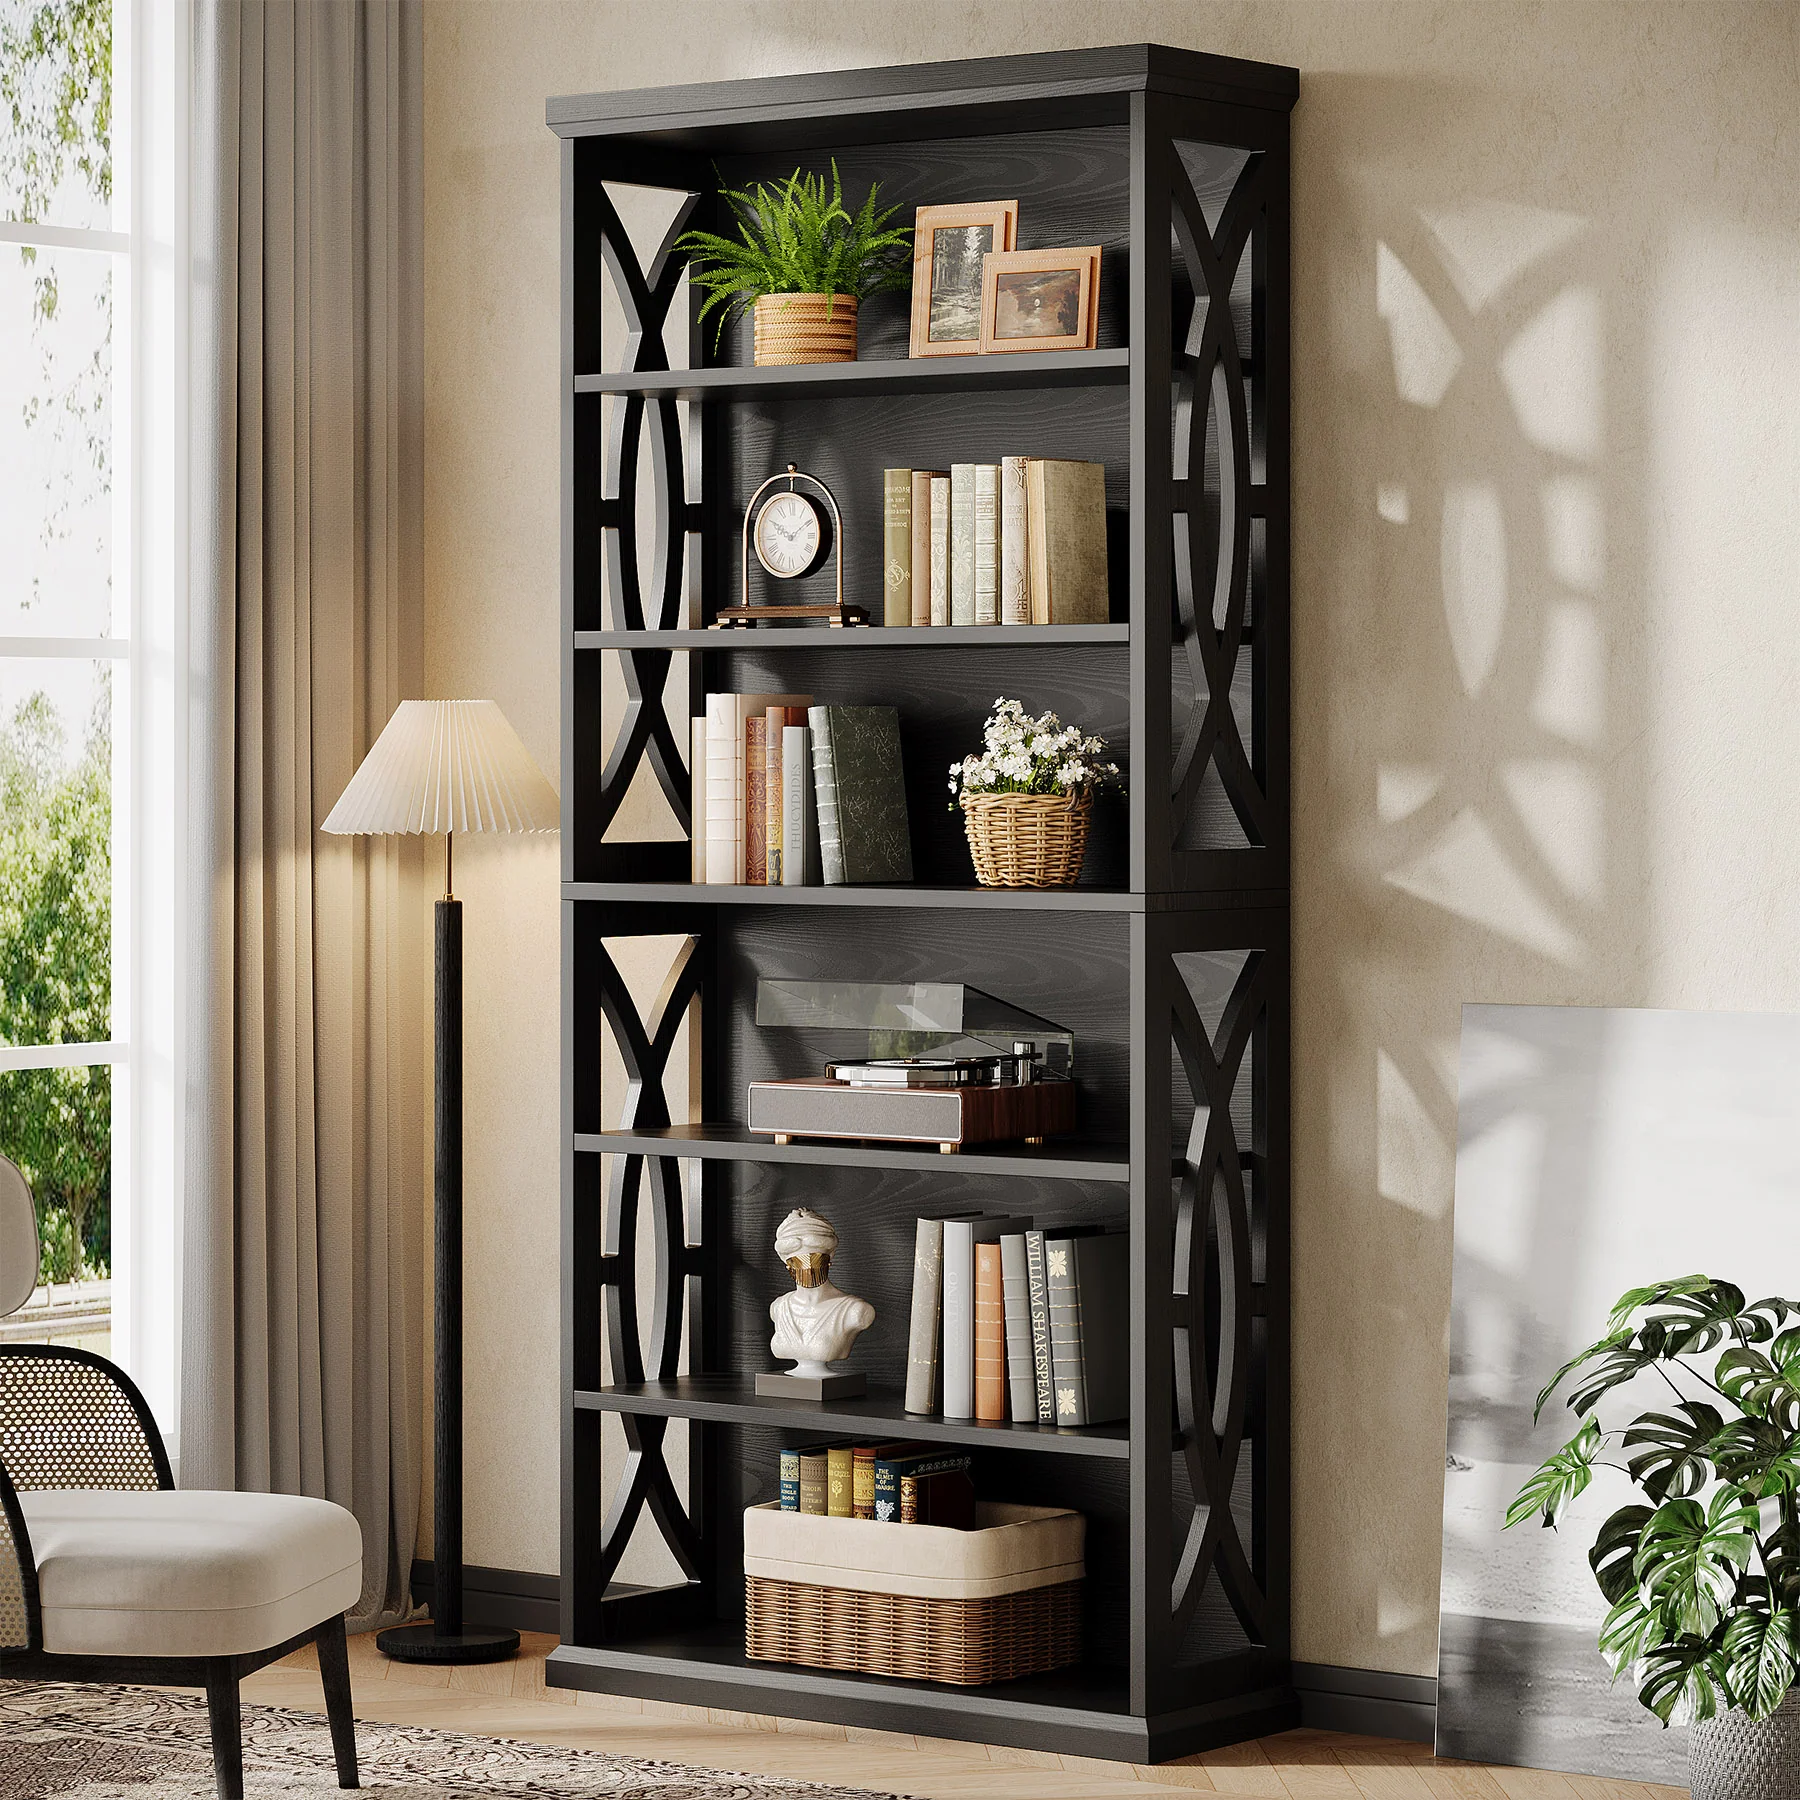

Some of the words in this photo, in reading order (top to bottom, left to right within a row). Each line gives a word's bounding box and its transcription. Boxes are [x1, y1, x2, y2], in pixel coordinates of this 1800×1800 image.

[791, 763, 801, 852] THUCYDIDES
[1027, 1234, 1042, 1308] WILLIAM
[1032, 1310, 1052, 1420] SHAKESPEARE
